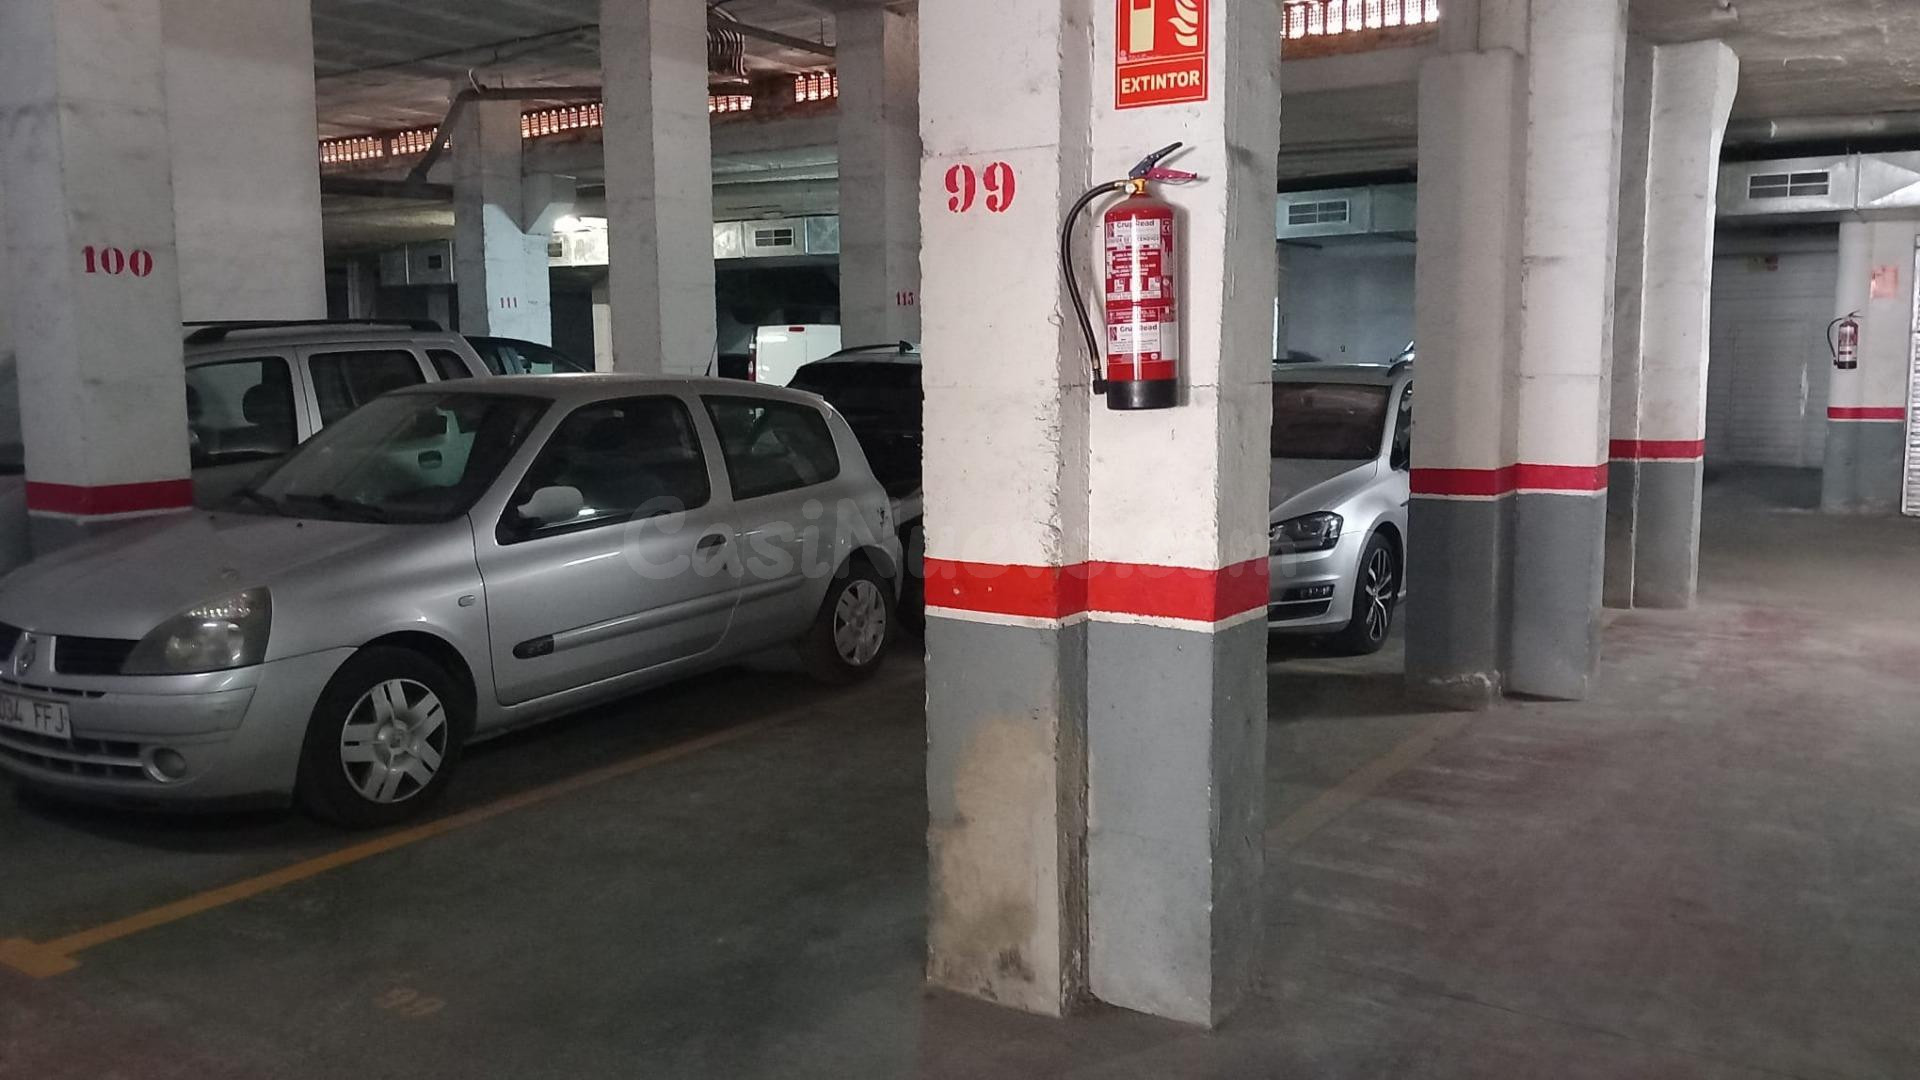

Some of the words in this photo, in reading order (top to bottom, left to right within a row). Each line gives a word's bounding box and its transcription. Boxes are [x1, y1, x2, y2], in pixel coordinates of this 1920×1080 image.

[1121, 70, 1200, 94] EXTINTOR
[945, 162, 1015, 212] 99
[82, 246, 153, 277] 100
[500, 297, 517, 308] 111
[33, 703, 64, 732] FFJ
